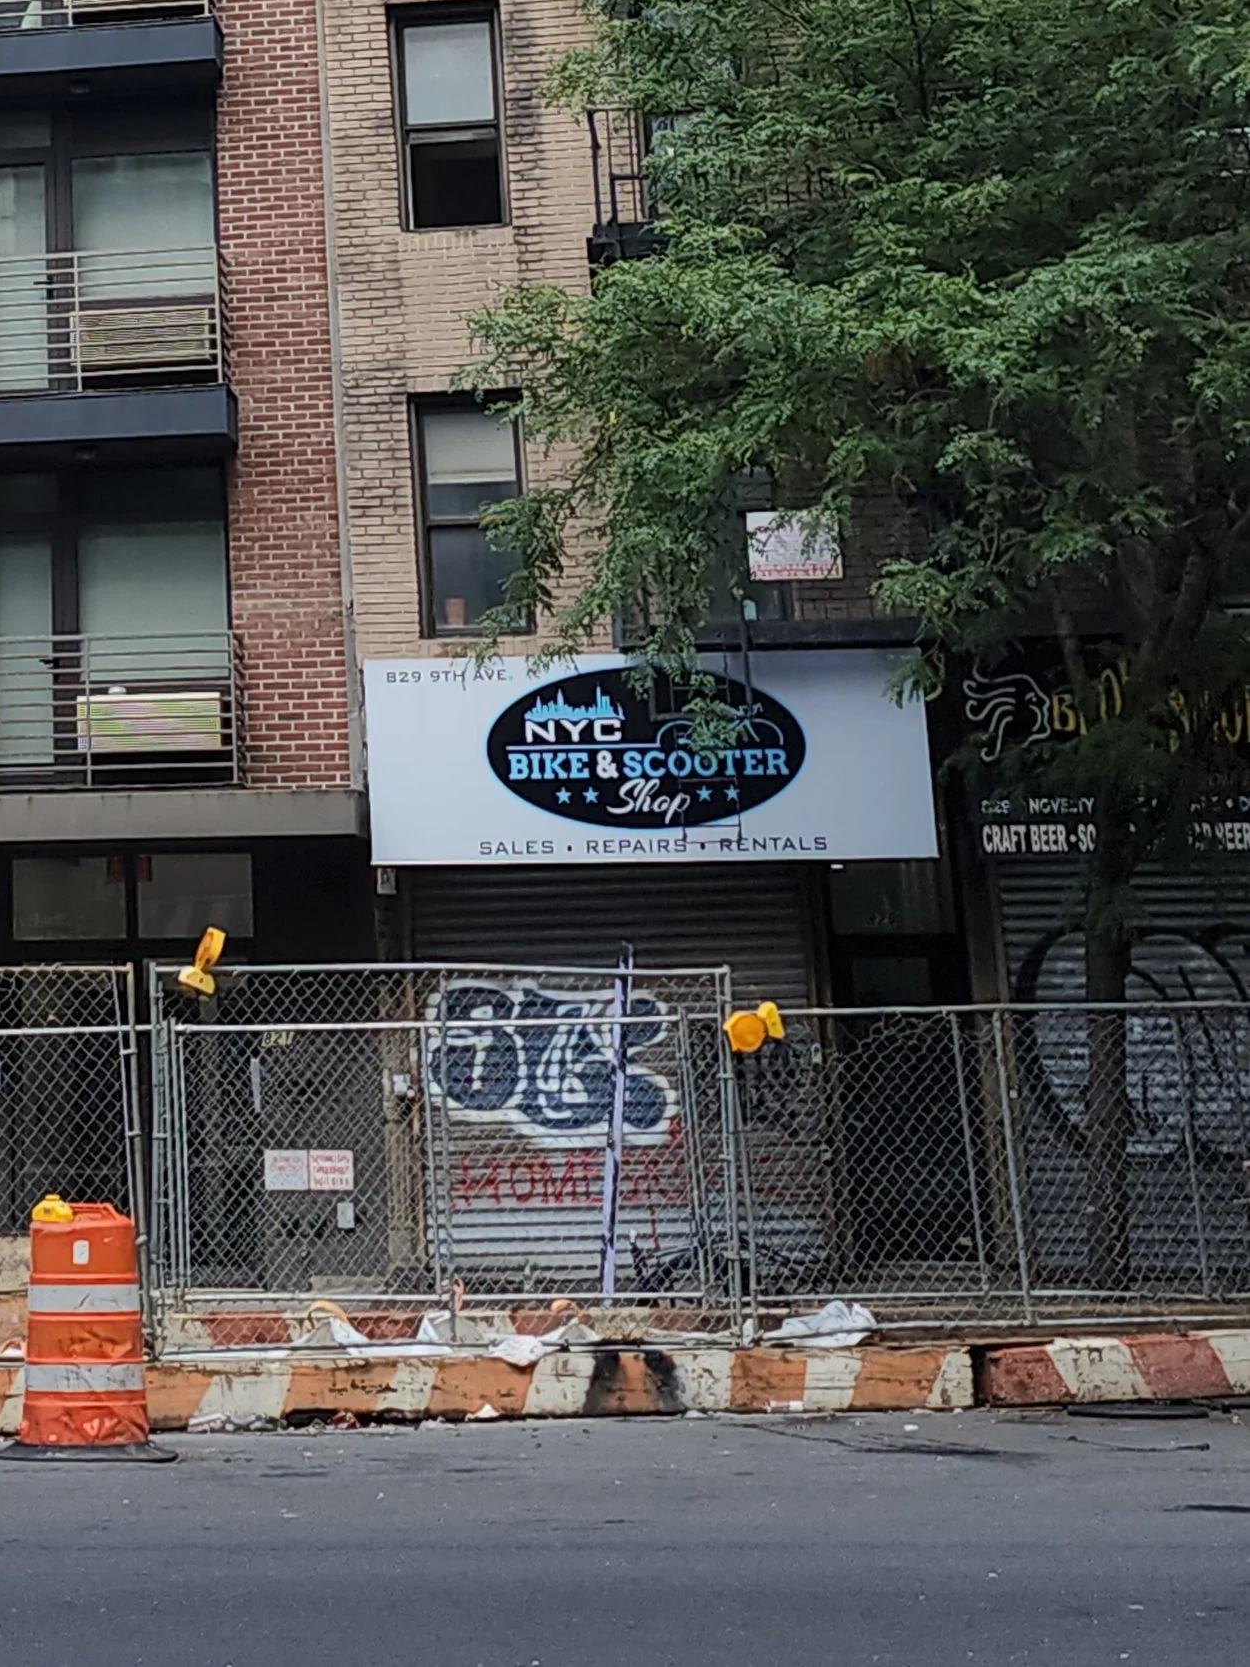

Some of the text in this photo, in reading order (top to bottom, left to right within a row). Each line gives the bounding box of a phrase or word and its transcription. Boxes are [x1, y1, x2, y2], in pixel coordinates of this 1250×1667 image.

[386, 671, 422, 683] 829
[430, 670, 465, 682] 9TH
[525, 719, 622, 743] NYC
[508, 748, 790, 780] BIKE & SCOOTER
[606, 778, 690, 824] Shop
[479, 836, 828, 855] SALES REPAIRS RENTALS
[982, 824, 1027, 853] CRAFT
[1030, 824, 1068, 853] BEER
